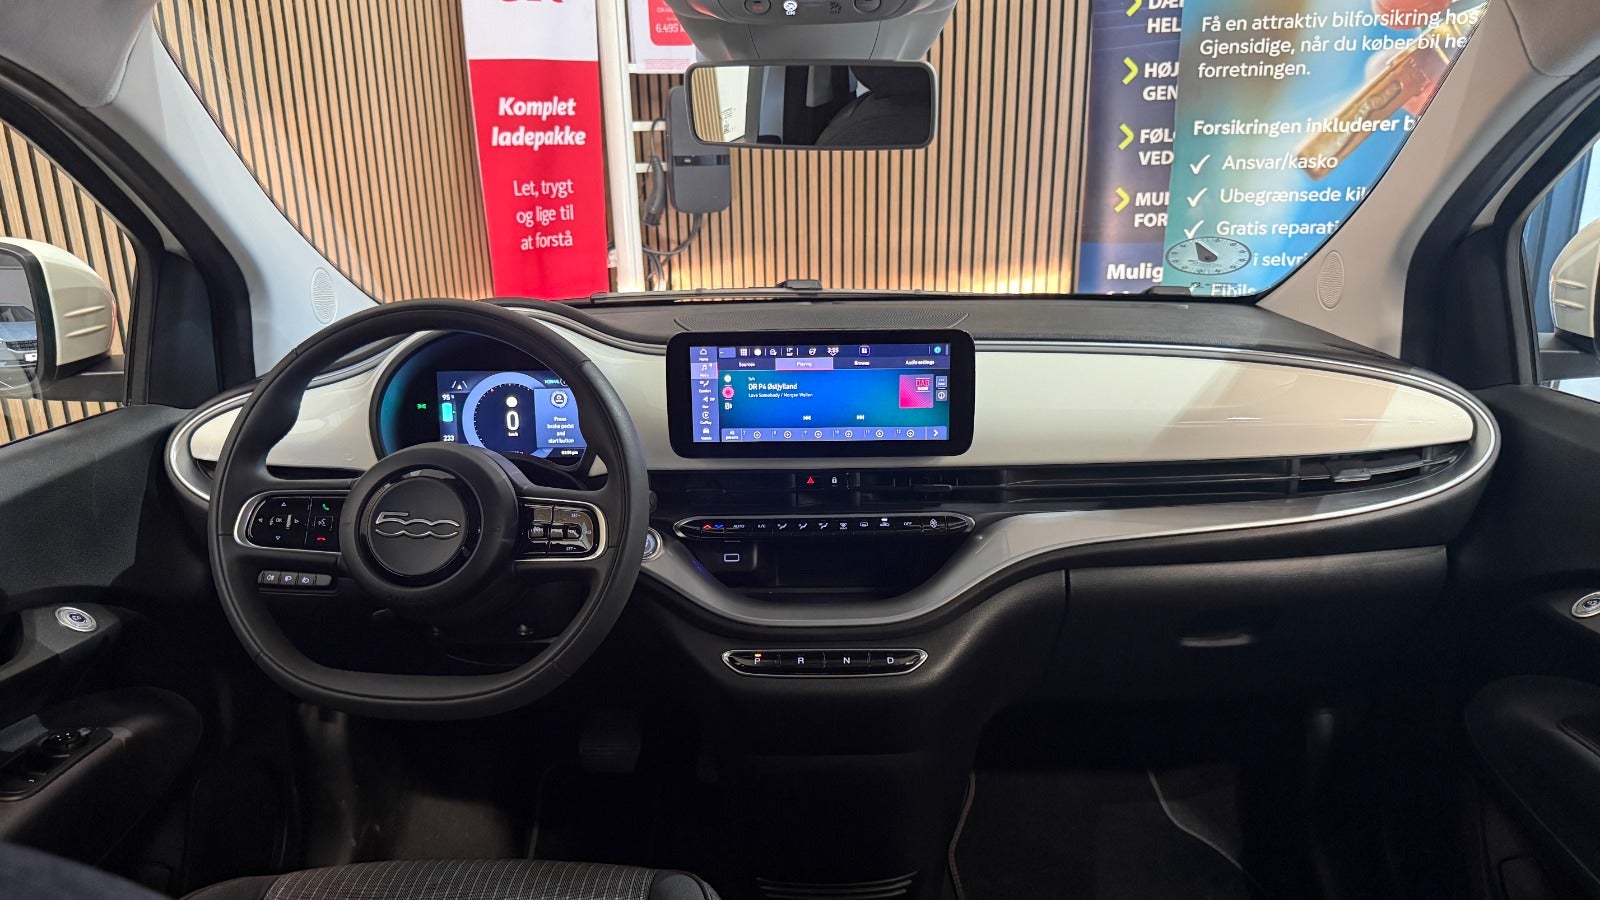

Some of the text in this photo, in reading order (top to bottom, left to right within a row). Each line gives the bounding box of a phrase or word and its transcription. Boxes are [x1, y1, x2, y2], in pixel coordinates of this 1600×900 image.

[1202, 9, 1479, 33] Få en attraktiv bilforsikring hos
[1199, 33, 1469, 59] Gjensidige, når du køber bil he
[1197, 61, 1311, 80] forretningen.
[499, 95, 577, 122] Komplet
[1140, 127, 1176, 144] FØL
[1193, 115, 1421, 138] Forsikringen inkluderer b
[491, 125, 587, 152] ladepakke
[1138, 150, 1174, 166] VED
[1221, 153, 1339, 172] Ansvar/kasko
[512, 178, 574, 199] Let, trygt
[1219, 186, 1342, 206] Ubegrænsede
[516, 203, 575, 228] og lige til
[1133, 213, 1169, 228] FOR
[1216, 219, 1268, 237] Gratis
[521, 229, 574, 251] at forstå
[1253, 252, 1258, 267] i
[1106, 262, 1164, 283] Mulig
[748, 382, 798, 392] DR P4 Østjylland
[506, 410, 520, 431] 0
[754, 657, 761, 665] P
[797, 656, 805, 665] R
[843, 656, 851, 665] N
[886, 656, 895, 665] D
